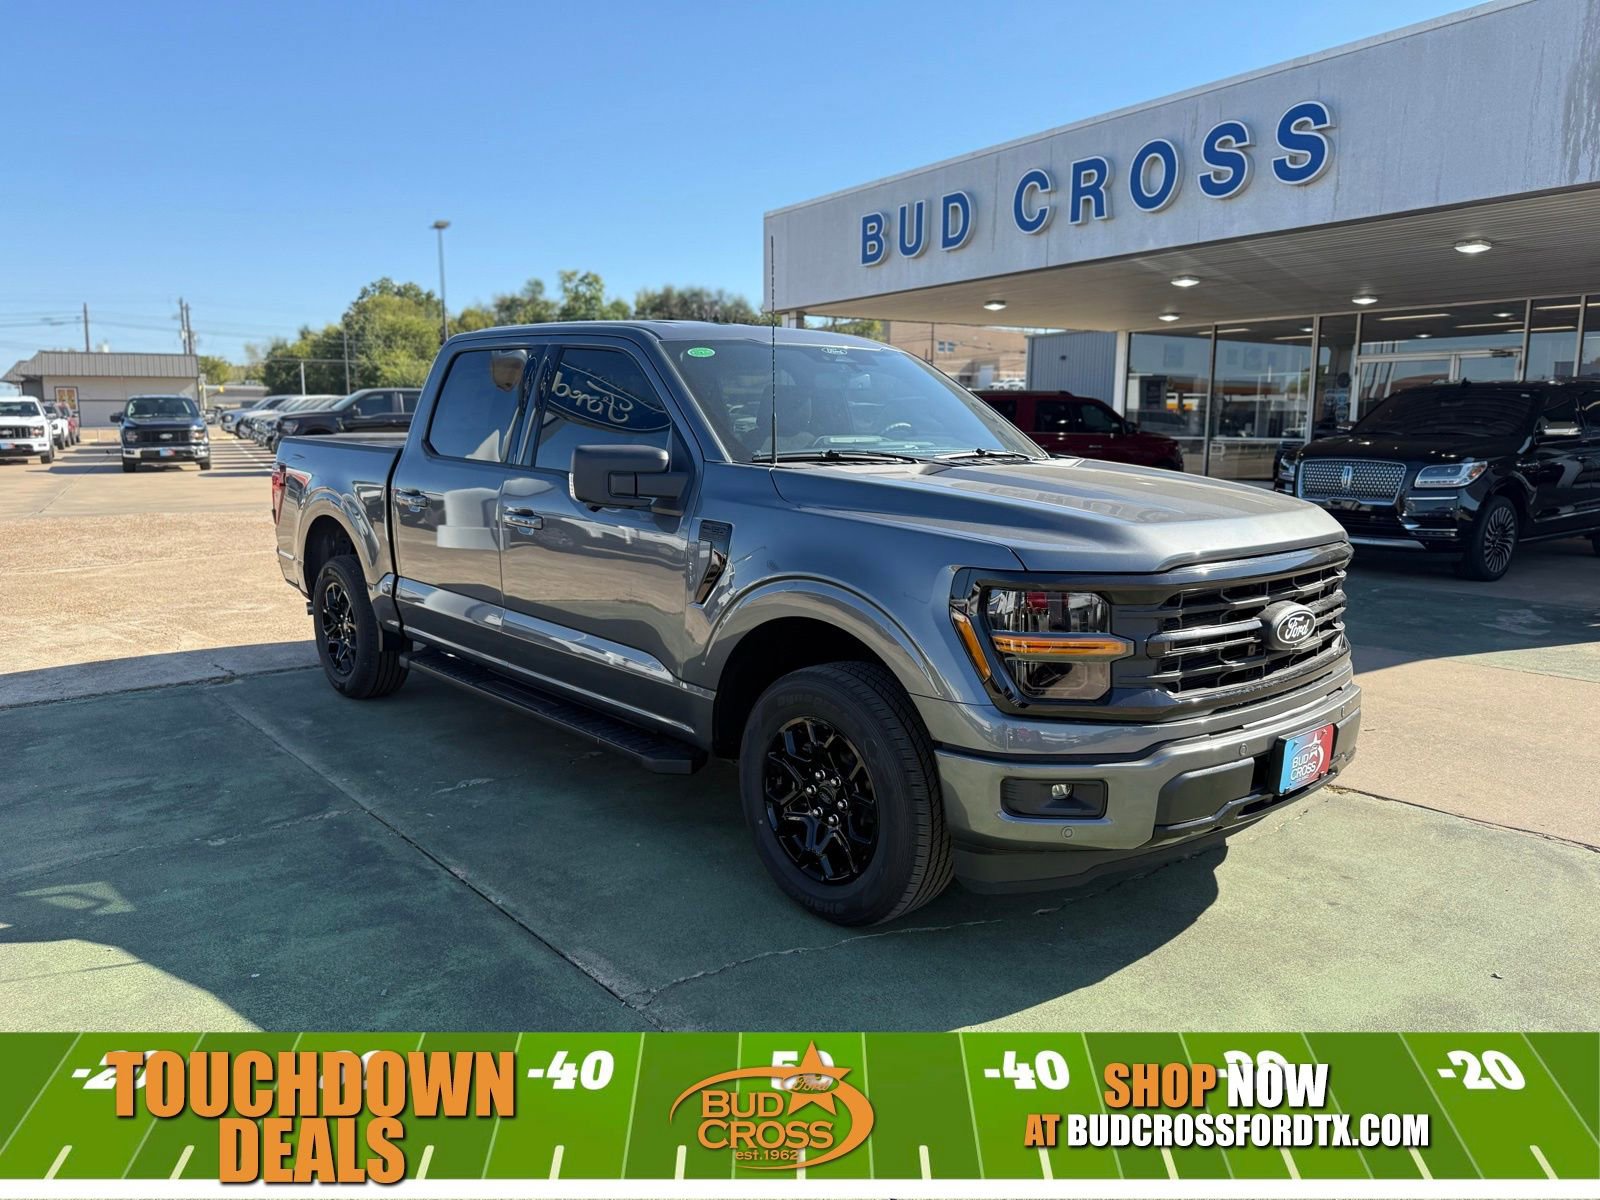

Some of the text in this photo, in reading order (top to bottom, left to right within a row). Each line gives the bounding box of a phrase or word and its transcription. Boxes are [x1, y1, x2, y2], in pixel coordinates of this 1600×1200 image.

[861, 100, 1335, 267] BUD CROSS
[1285, 616, 1309, 640] Ford
[1291, 761, 1316, 780] CROSS
[1292, 754, 1308, 769] BUD
